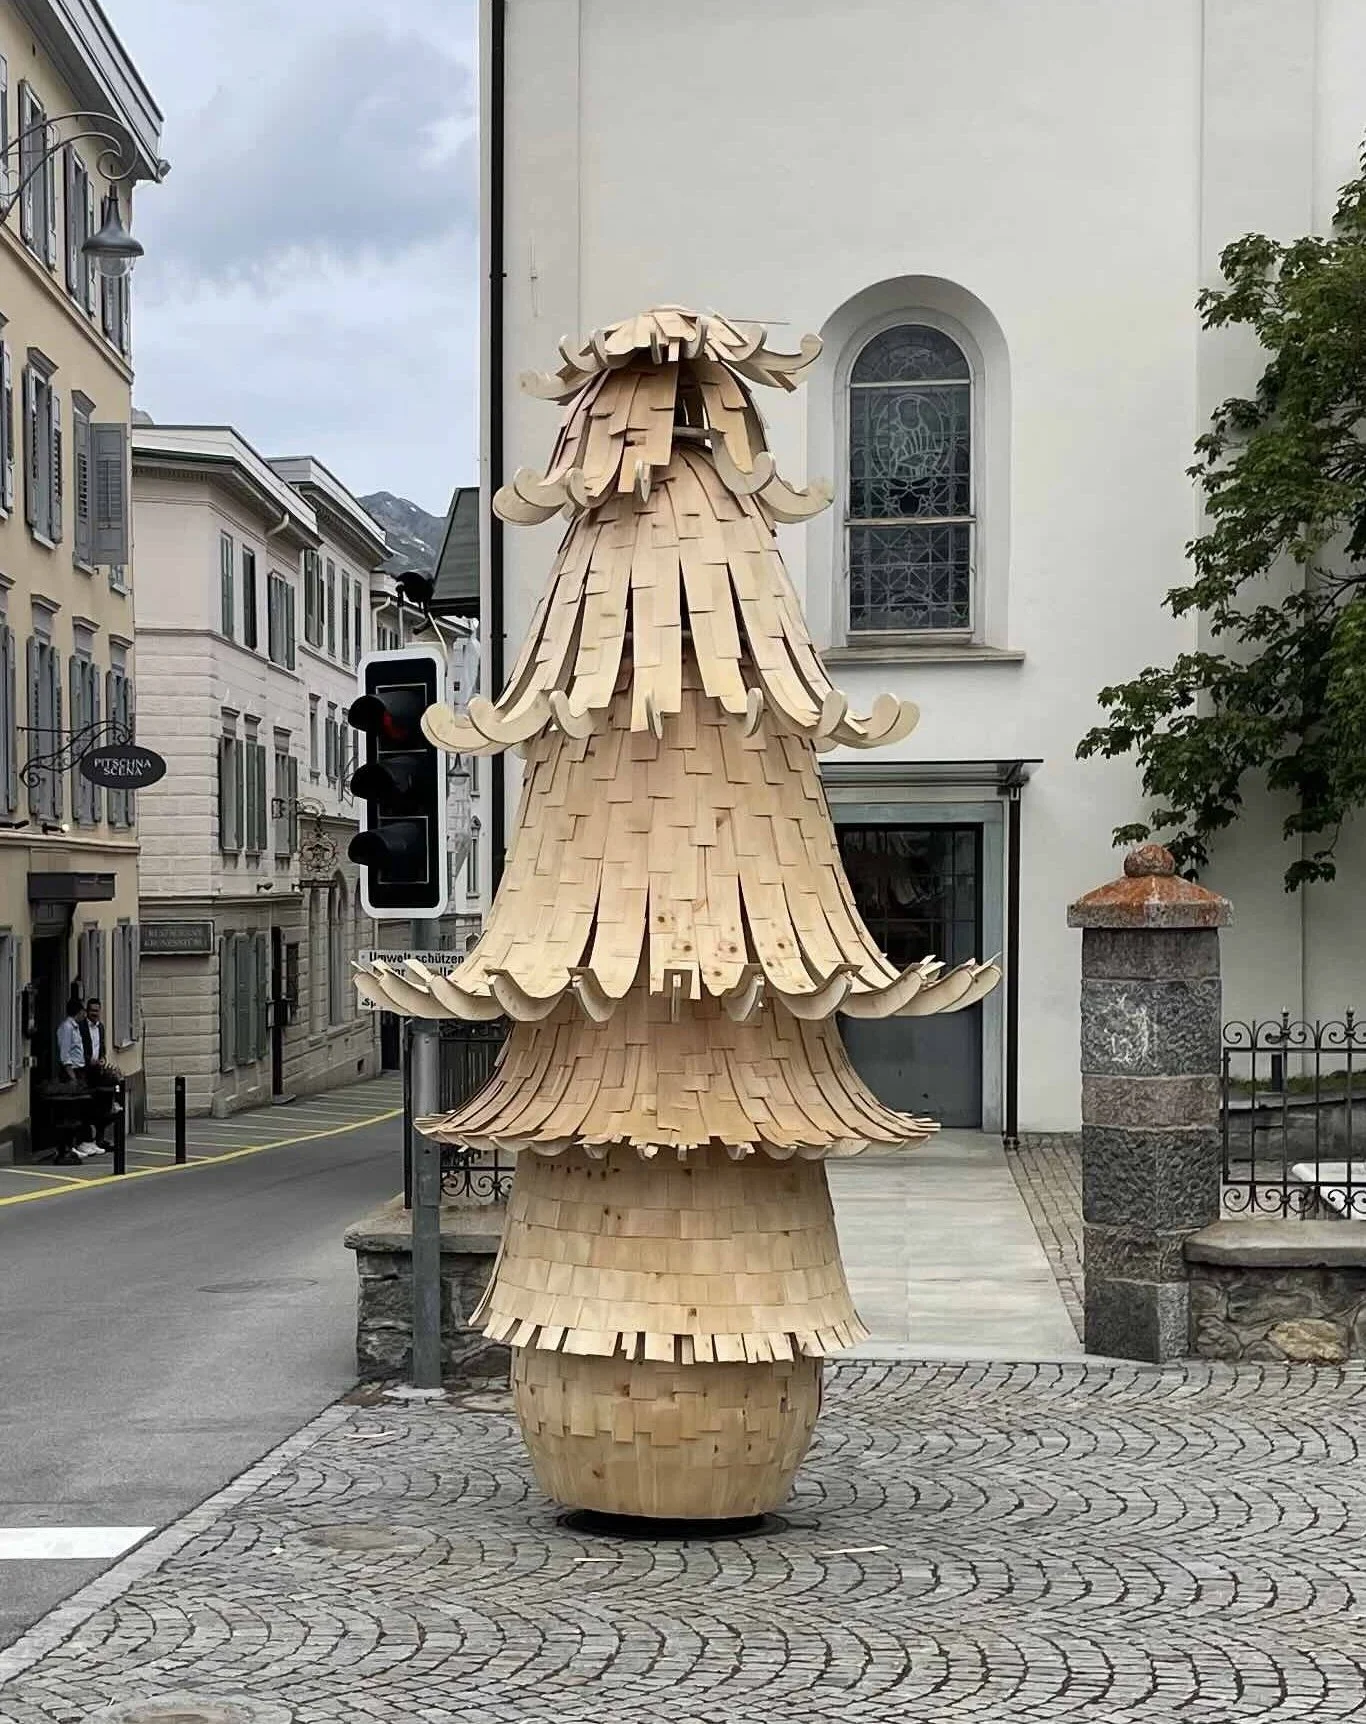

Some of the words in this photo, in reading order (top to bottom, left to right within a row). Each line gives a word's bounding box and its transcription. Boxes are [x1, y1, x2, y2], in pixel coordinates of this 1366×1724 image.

[94, 758, 152, 768] PITSCHNA
[103, 767, 143, 776] SCENA
[416, 952, 465, 964] schützen
